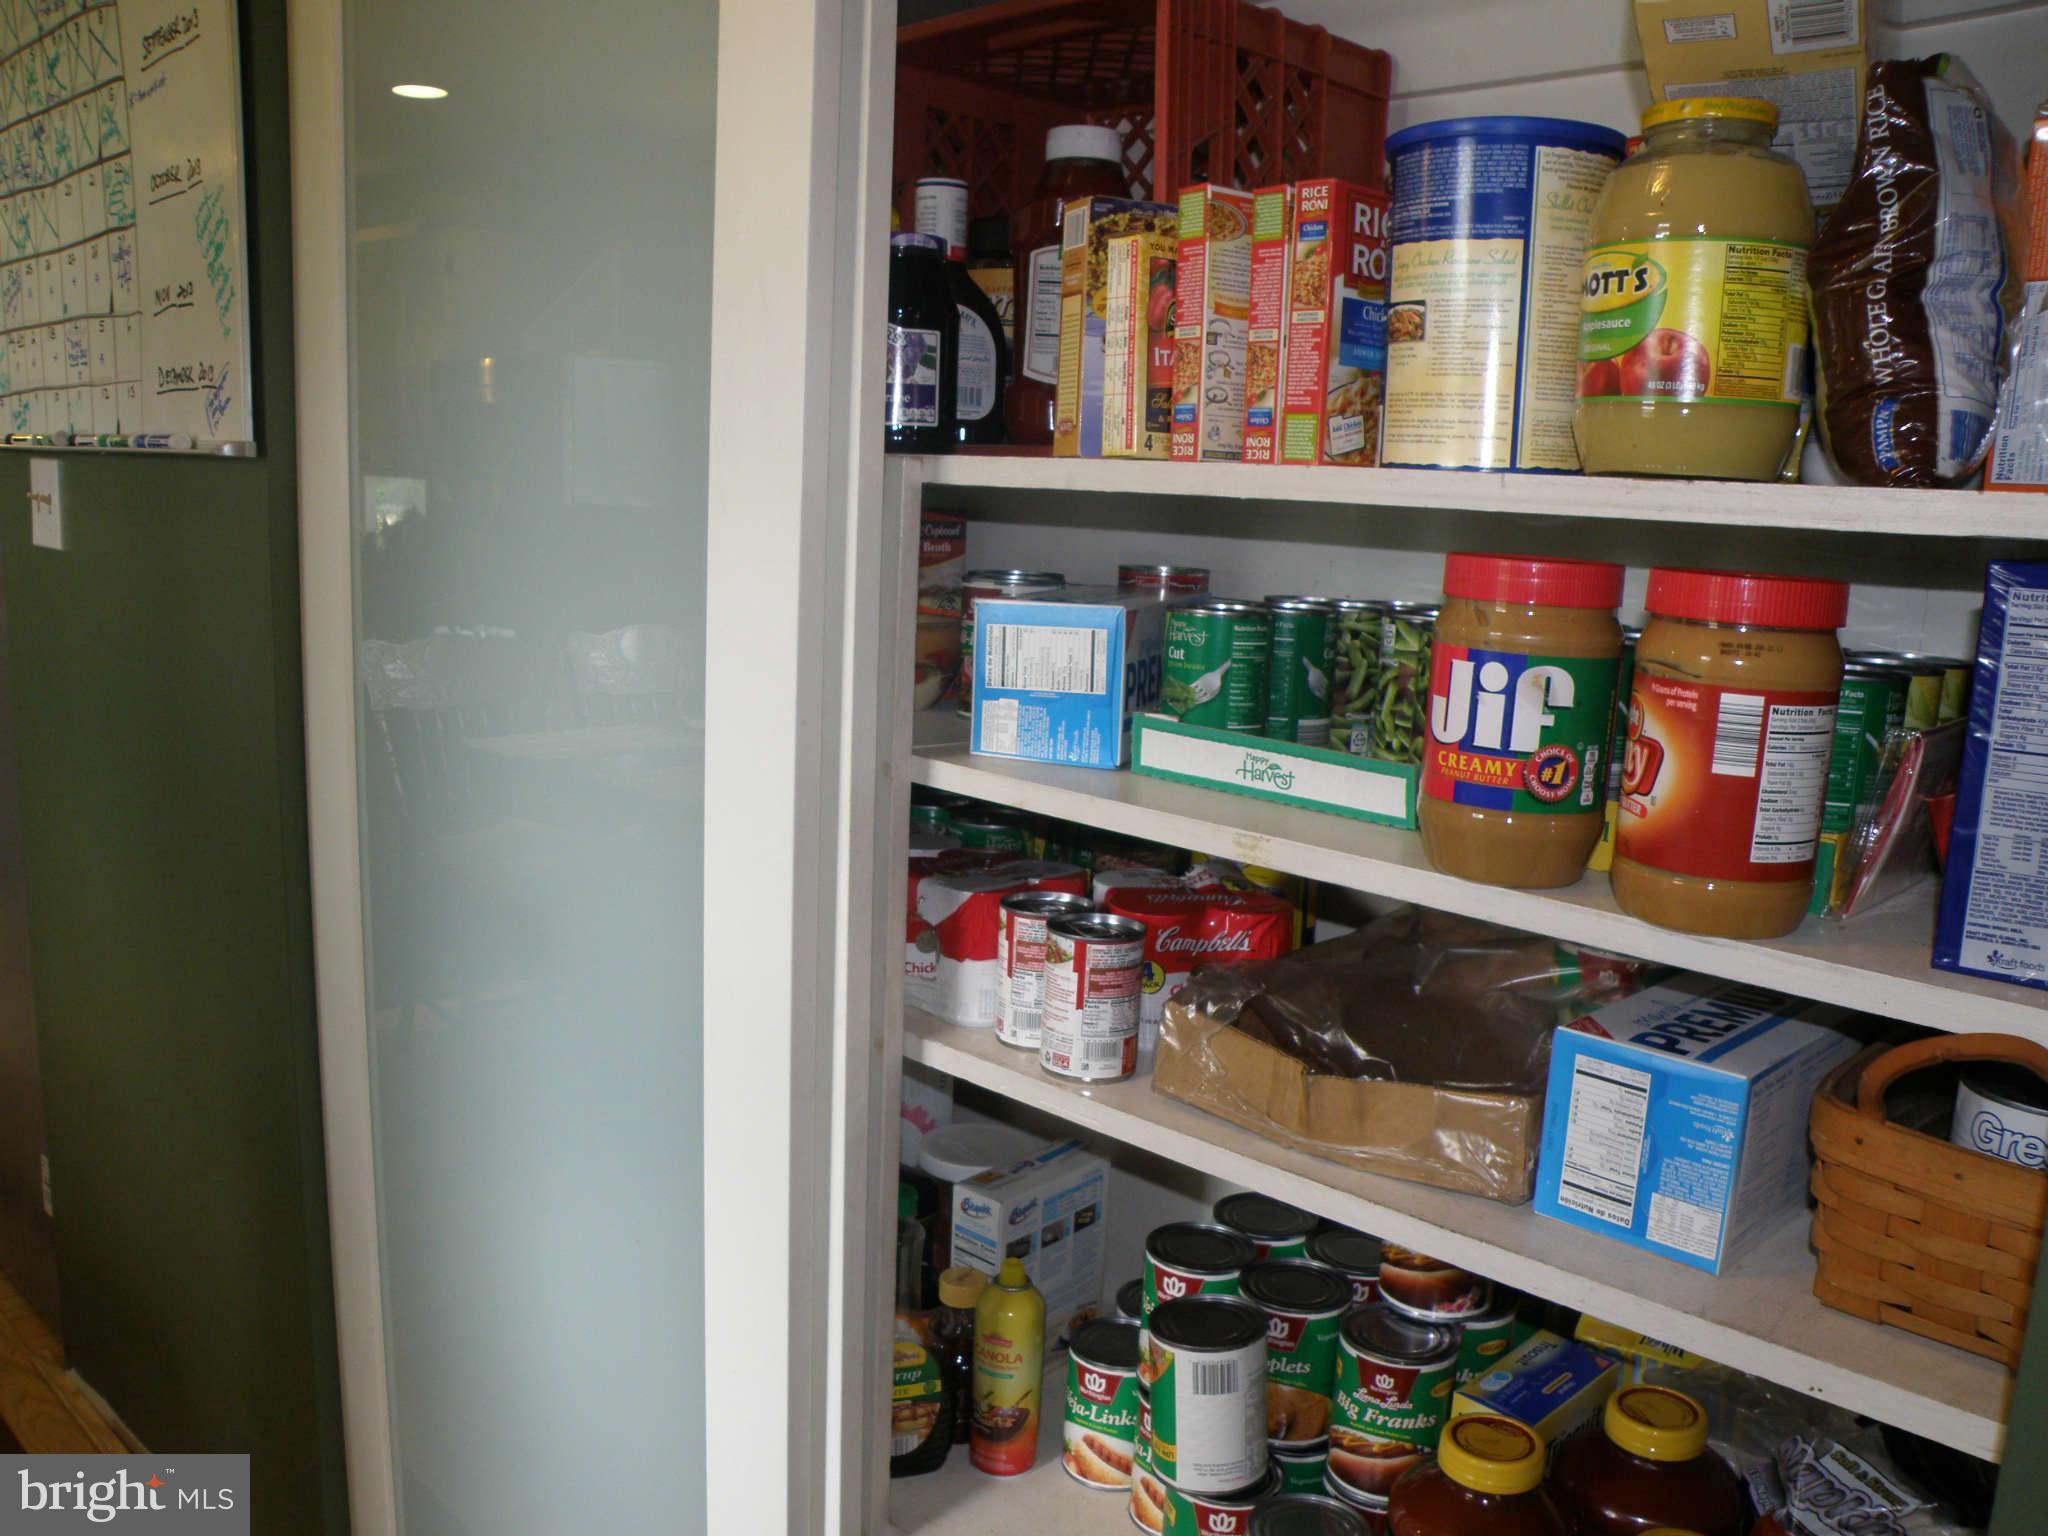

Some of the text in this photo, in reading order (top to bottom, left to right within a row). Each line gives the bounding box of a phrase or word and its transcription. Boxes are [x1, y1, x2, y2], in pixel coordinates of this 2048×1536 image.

[1865, 83, 1889, 140] RICE
[1302, 185, 1329, 199] RICE
[1872, 144, 1900, 233] BROWN
[1352, 243, 1387, 280] RO
[1728, 245, 1771, 257] Nutrition
[1363, 306, 1388, 322] Chic
[1866, 302, 1893, 386] WHOLE
[1172, 445, 1195, 457] RICE
[1245, 449, 1271, 461] RICE
[1996, 434, 2010, 481] Nutrition
[1168, 646, 1185, 659] Cut
[1431, 658, 1575, 753] Jif
[1771, 706, 1815, 717] Nutrition
[1245, 752, 1270, 767] Happy
[1438, 749, 1518, 778] CREAMY
[1540, 759, 1567, 785] #1
[1235, 760, 1296, 791] Harvest
[1441, 766, 1510, 786] PEANUT BUTTER
[1155, 925, 1252, 957] Campbell's
[1970, 1111, 2048, 1168] Gre
[895, 1368, 922, 1382] rup
[1336, 1390, 1438, 1431] Big Franks
